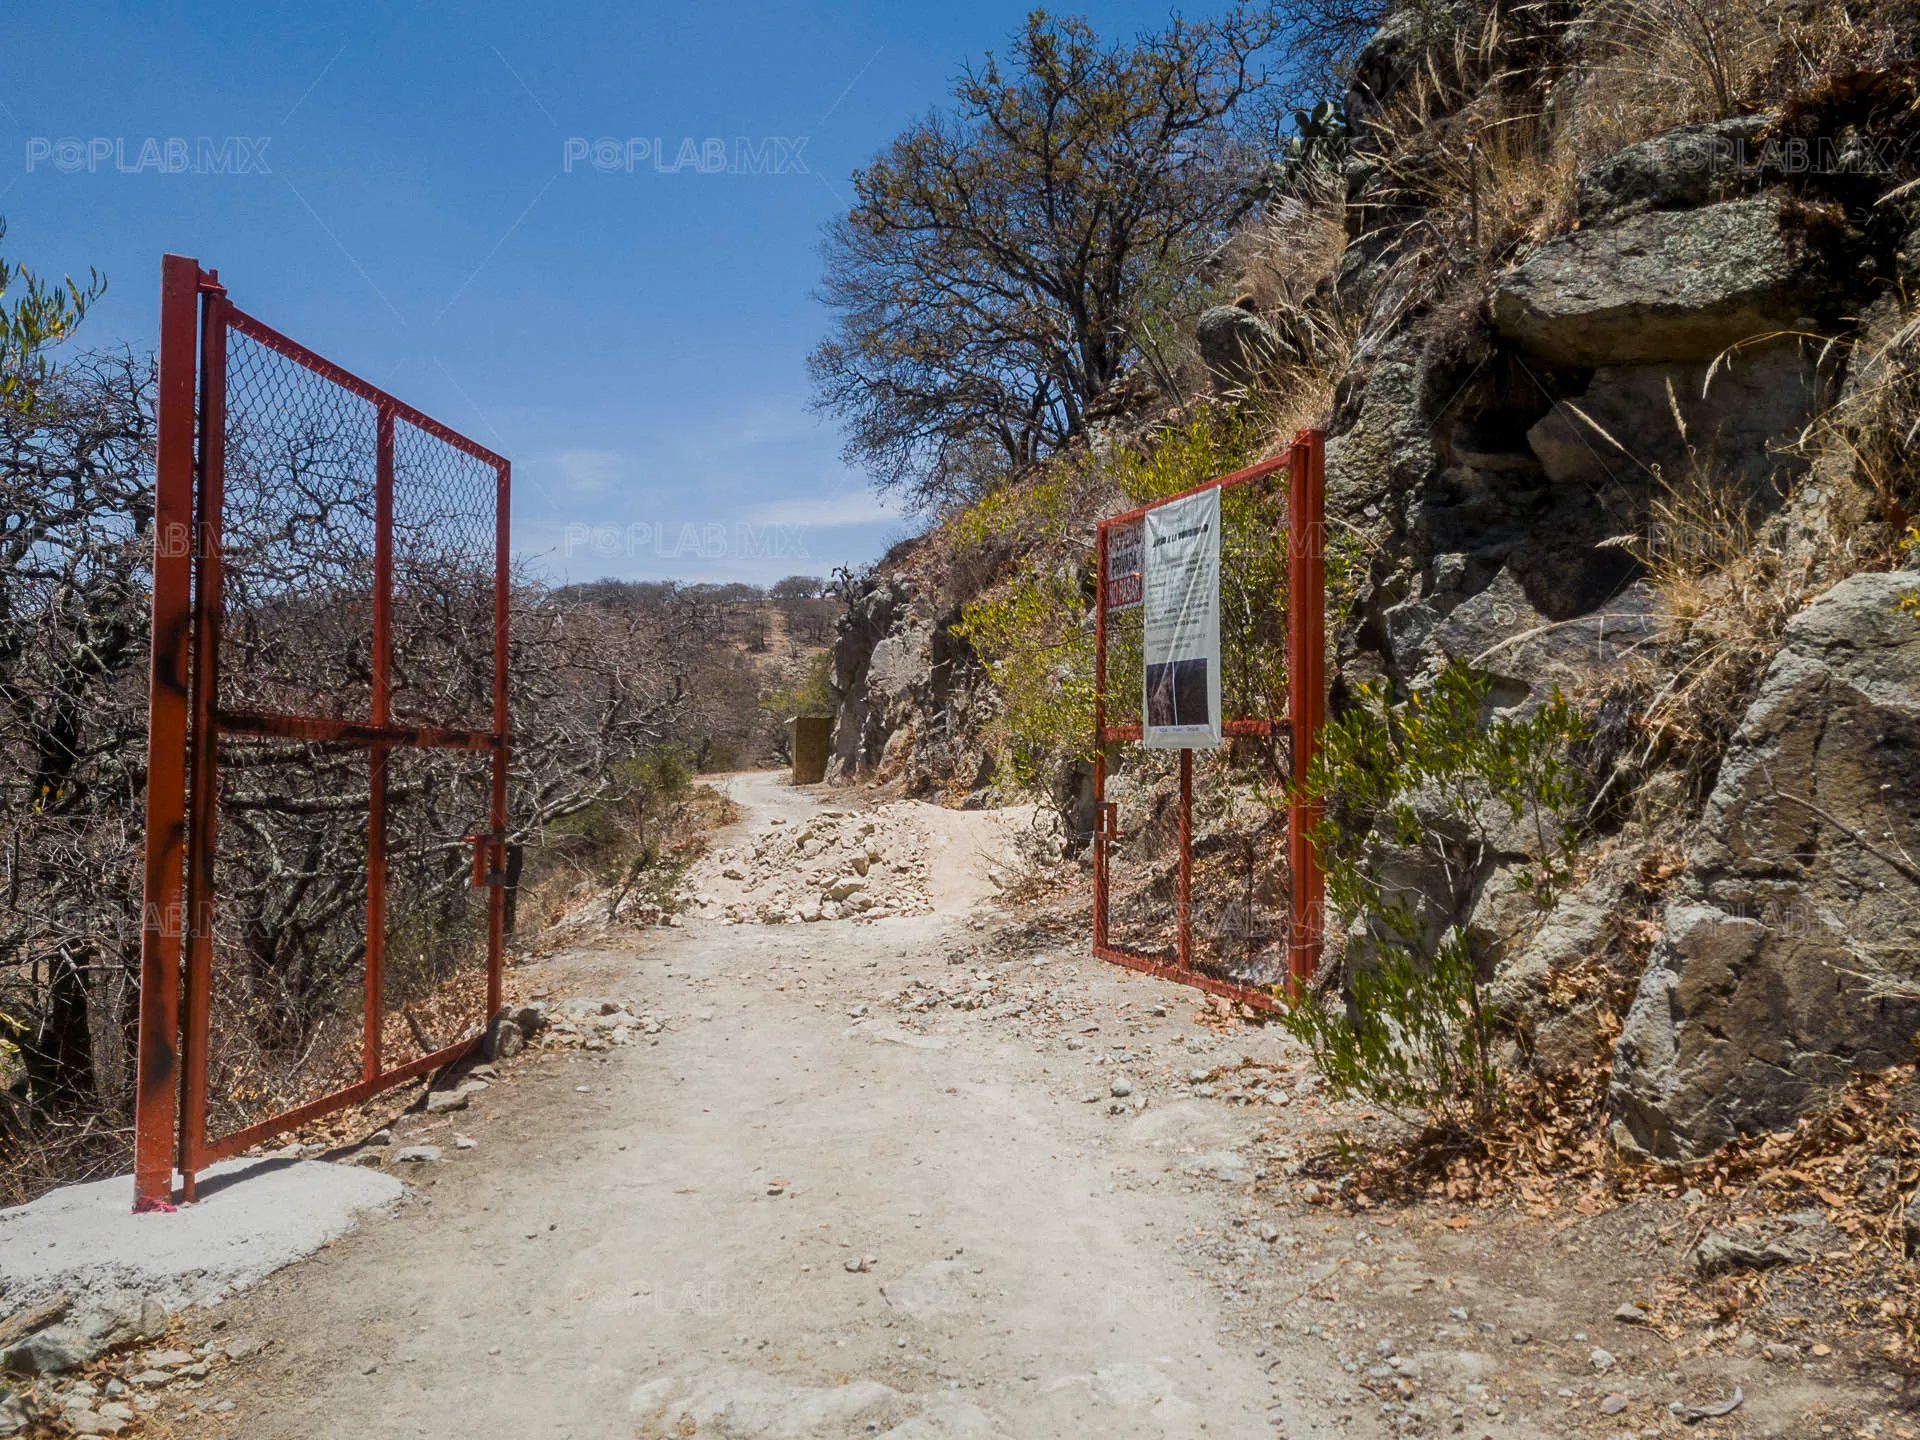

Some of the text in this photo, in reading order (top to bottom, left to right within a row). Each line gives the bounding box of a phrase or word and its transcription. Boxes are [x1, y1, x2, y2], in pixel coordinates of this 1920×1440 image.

[1112, 550, 1137, 578] PRIVADA
[1109, 573, 1140, 608] NO PASAR
